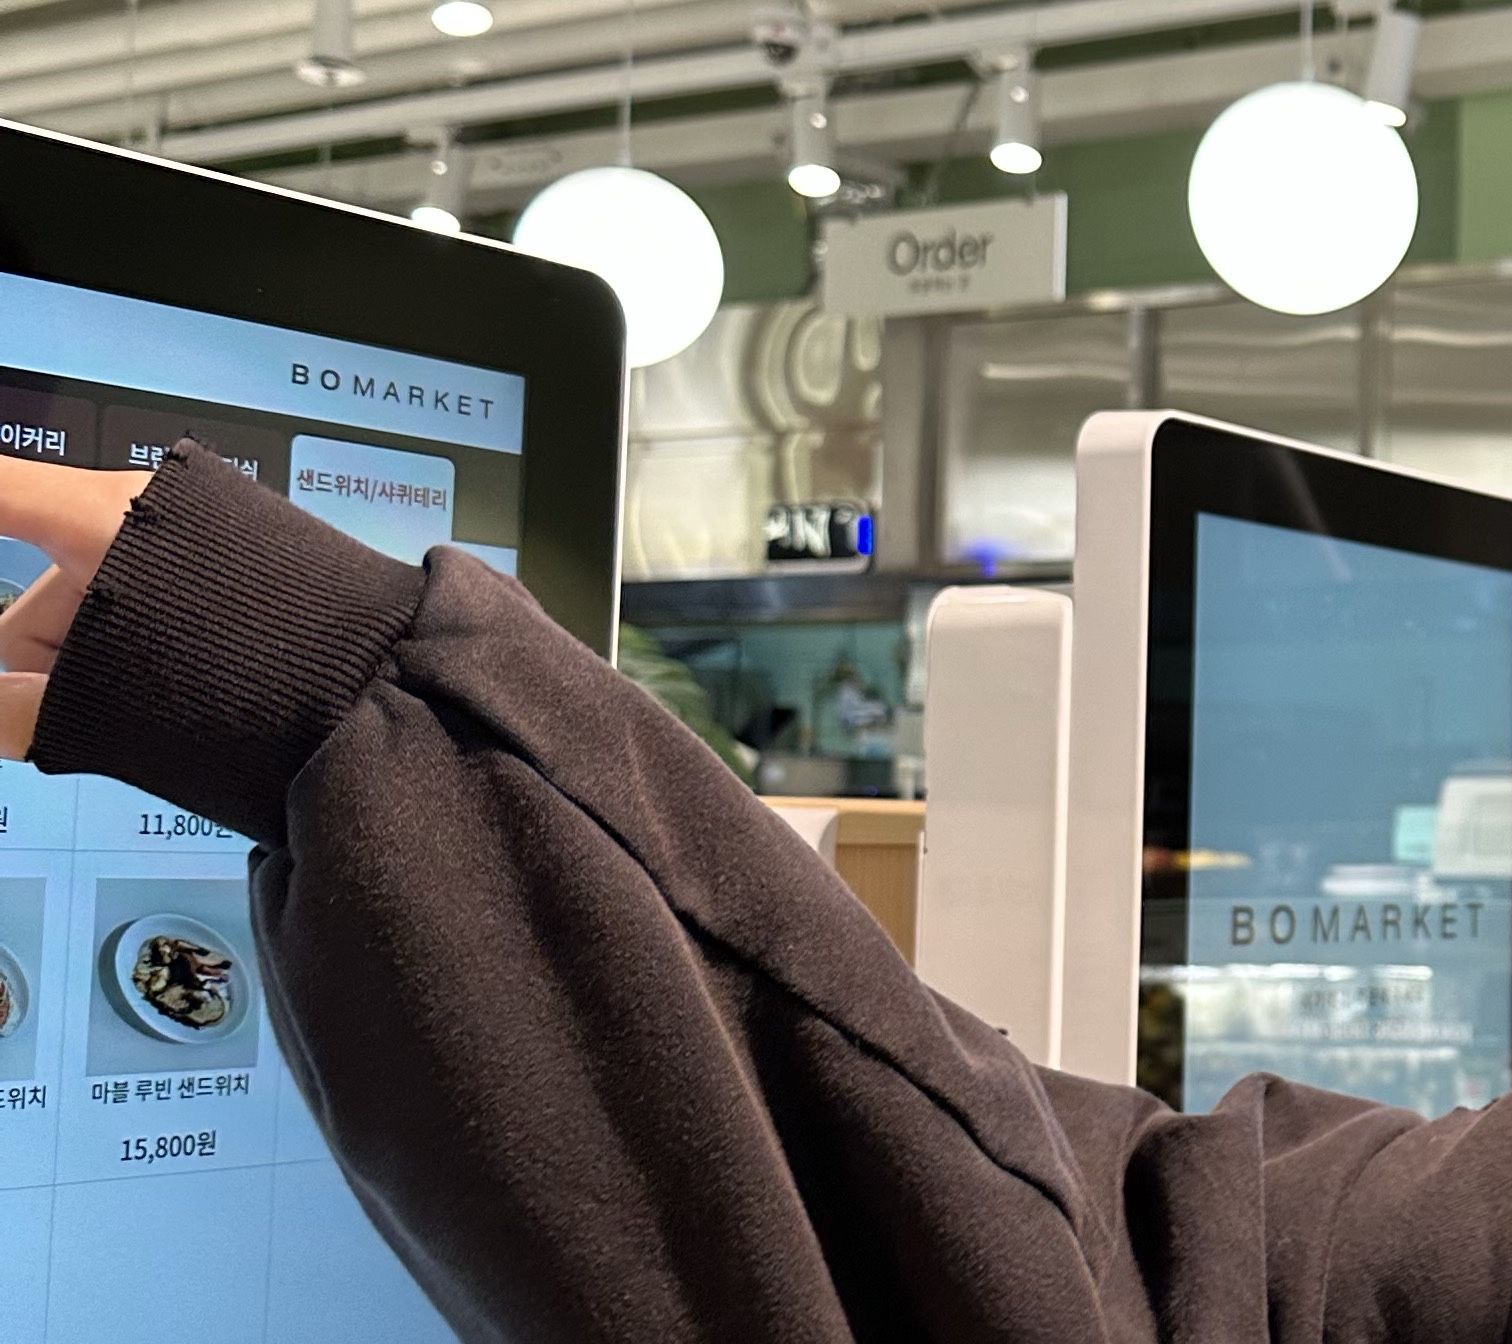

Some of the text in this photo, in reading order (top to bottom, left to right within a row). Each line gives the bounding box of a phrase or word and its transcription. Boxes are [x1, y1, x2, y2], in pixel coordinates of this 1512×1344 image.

[887, 224, 993, 276] Order
[92, 1073, 250, 1104] 마블 루빈 샌드위치
[120, 1130, 217, 1164] 15,800원
